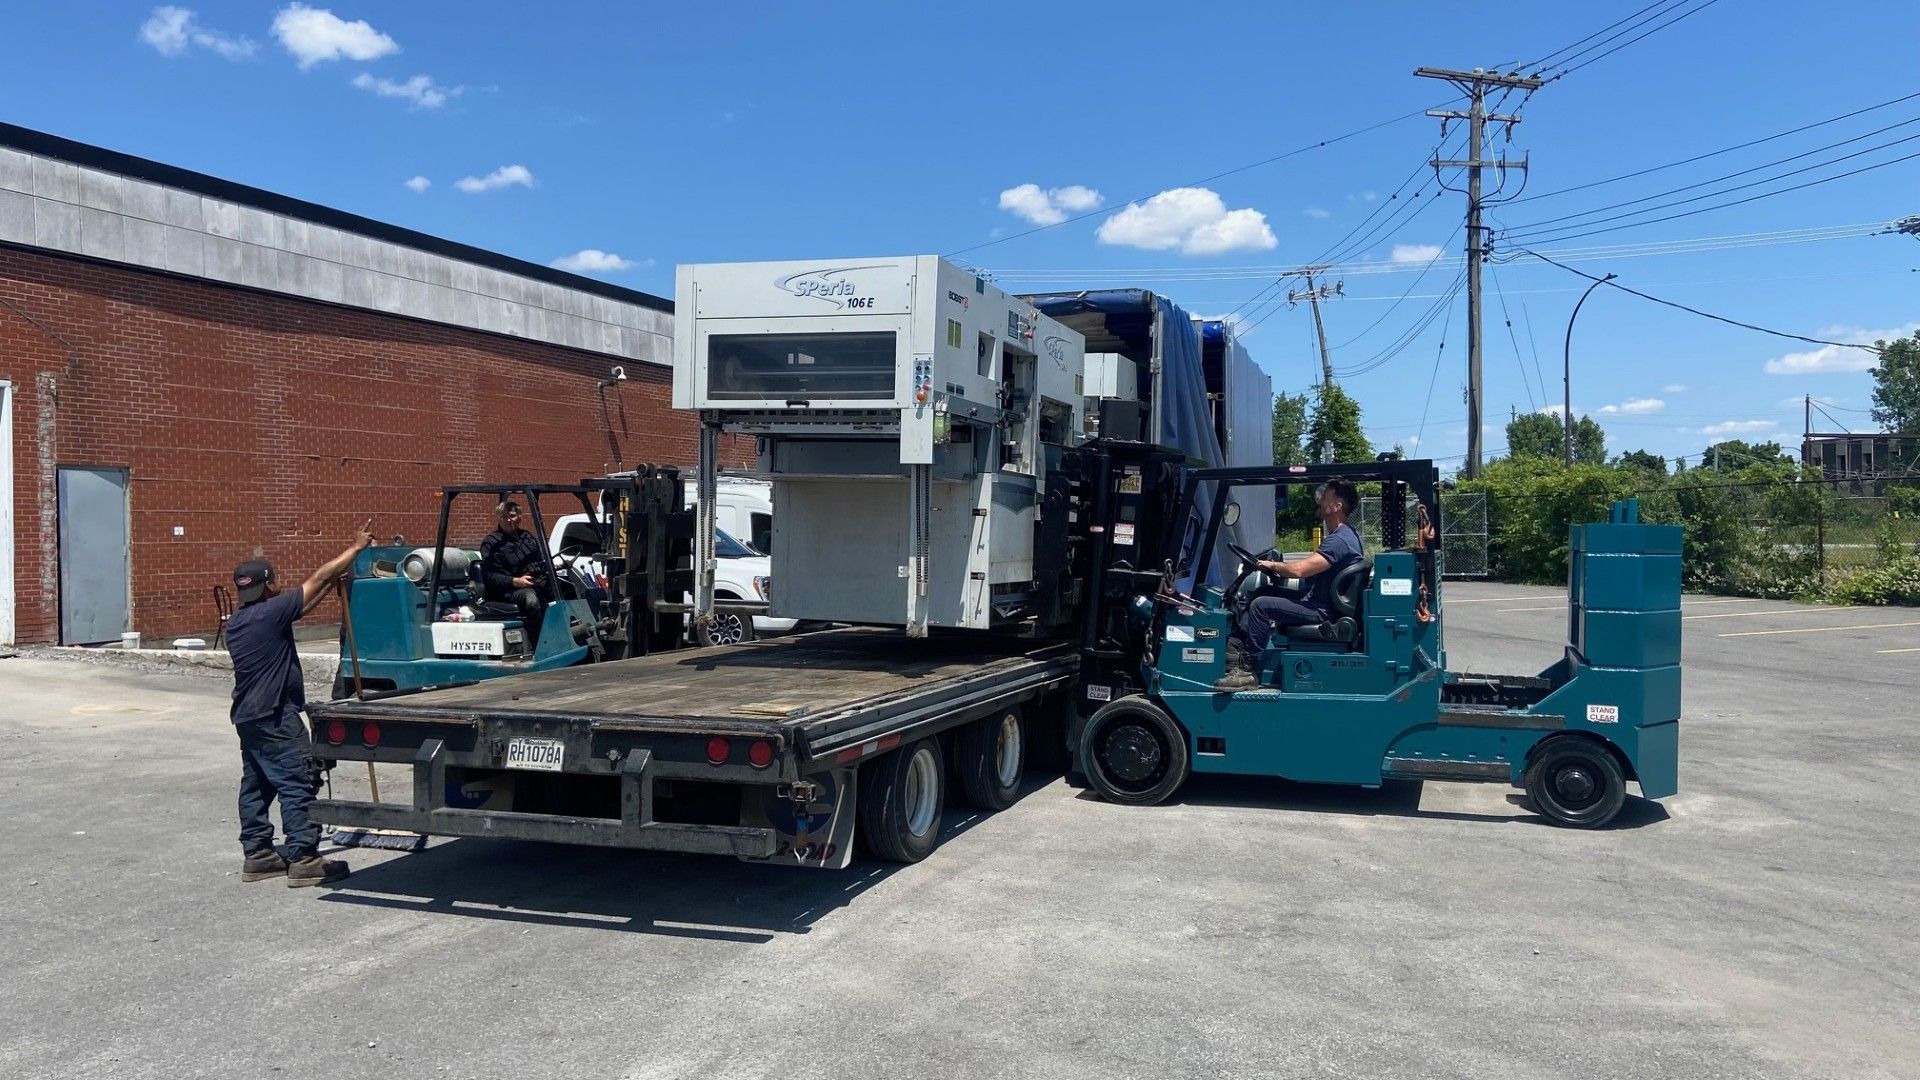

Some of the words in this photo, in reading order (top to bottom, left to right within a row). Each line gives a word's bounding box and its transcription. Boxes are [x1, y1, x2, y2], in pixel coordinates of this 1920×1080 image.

[794, 279, 855, 297] SPeria
[847, 298, 865, 308] 106
[867, 297, 875, 308] E
[450, 642, 492, 651] HYSTER
[1590, 706, 1615, 714] STAND
[1590, 713, 1615, 722] CLEAR
[509, 744, 561, 764] RH1078A
